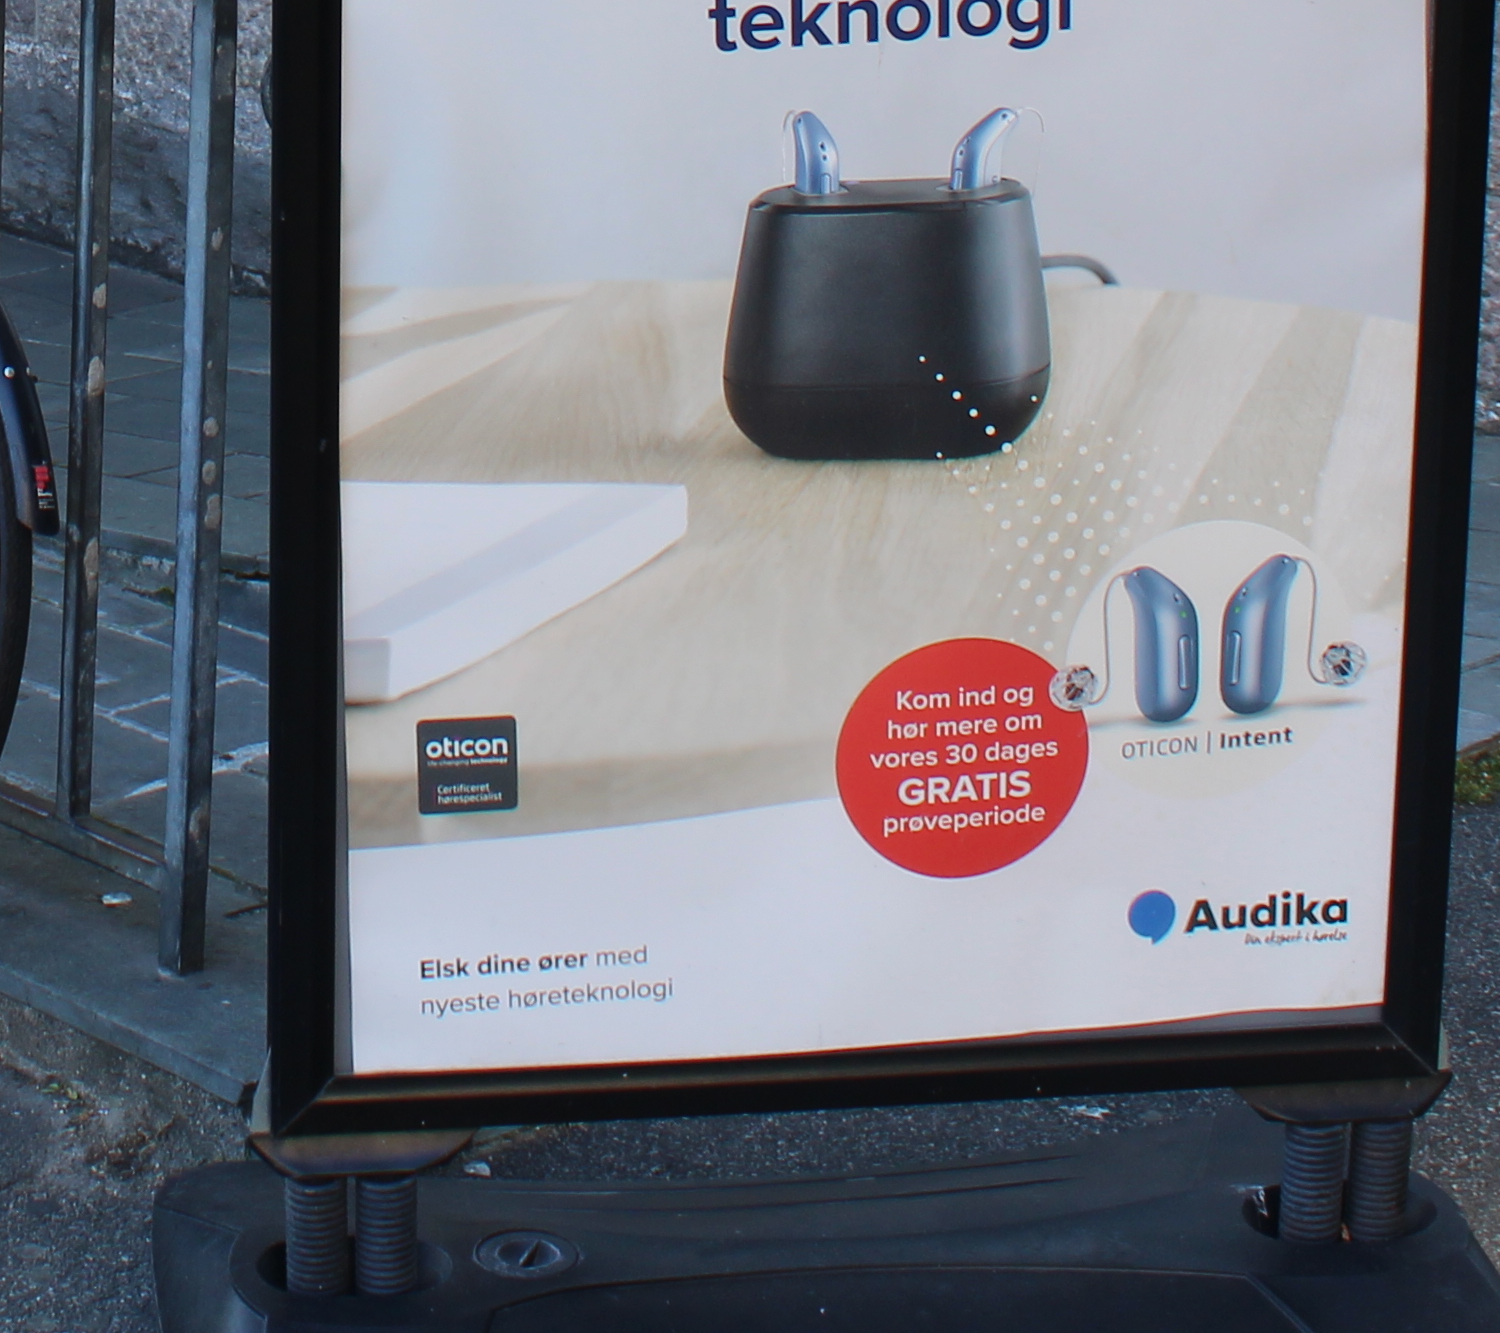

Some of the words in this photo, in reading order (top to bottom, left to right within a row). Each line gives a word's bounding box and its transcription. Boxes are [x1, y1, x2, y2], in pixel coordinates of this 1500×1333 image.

[896, 690, 950, 711] Kom
[959, 685, 996, 707] ind
[1003, 686, 1034, 708] og
[887, 719, 928, 739] hør
[936, 717, 998, 736] mere
[1004, 713, 1042, 732] om
[426, 736, 509, 759] oticon
[870, 749, 938, 769] vores
[945, 743, 978, 764] 30
[984, 740, 1059, 764] dages
[1121, 735, 1199, 759] OTICON
[1220, 726, 1293, 749] Intent
[437, 783, 490, 795] Certificeret
[437, 792, 503, 805] hørespecialist
[897, 770, 1032, 806] GRATIS
[883, 803, 1046, 838] prøveperiode
[1183, 890, 1348, 933] Audika
[420, 957, 470, 979] Elsk
[477, 953, 531, 976] dine
[538, 951, 589, 971] ører
[596, 944, 648, 967] med
[421, 992, 500, 1019] nyeste
[508, 977, 674, 1009] høreteknologi
